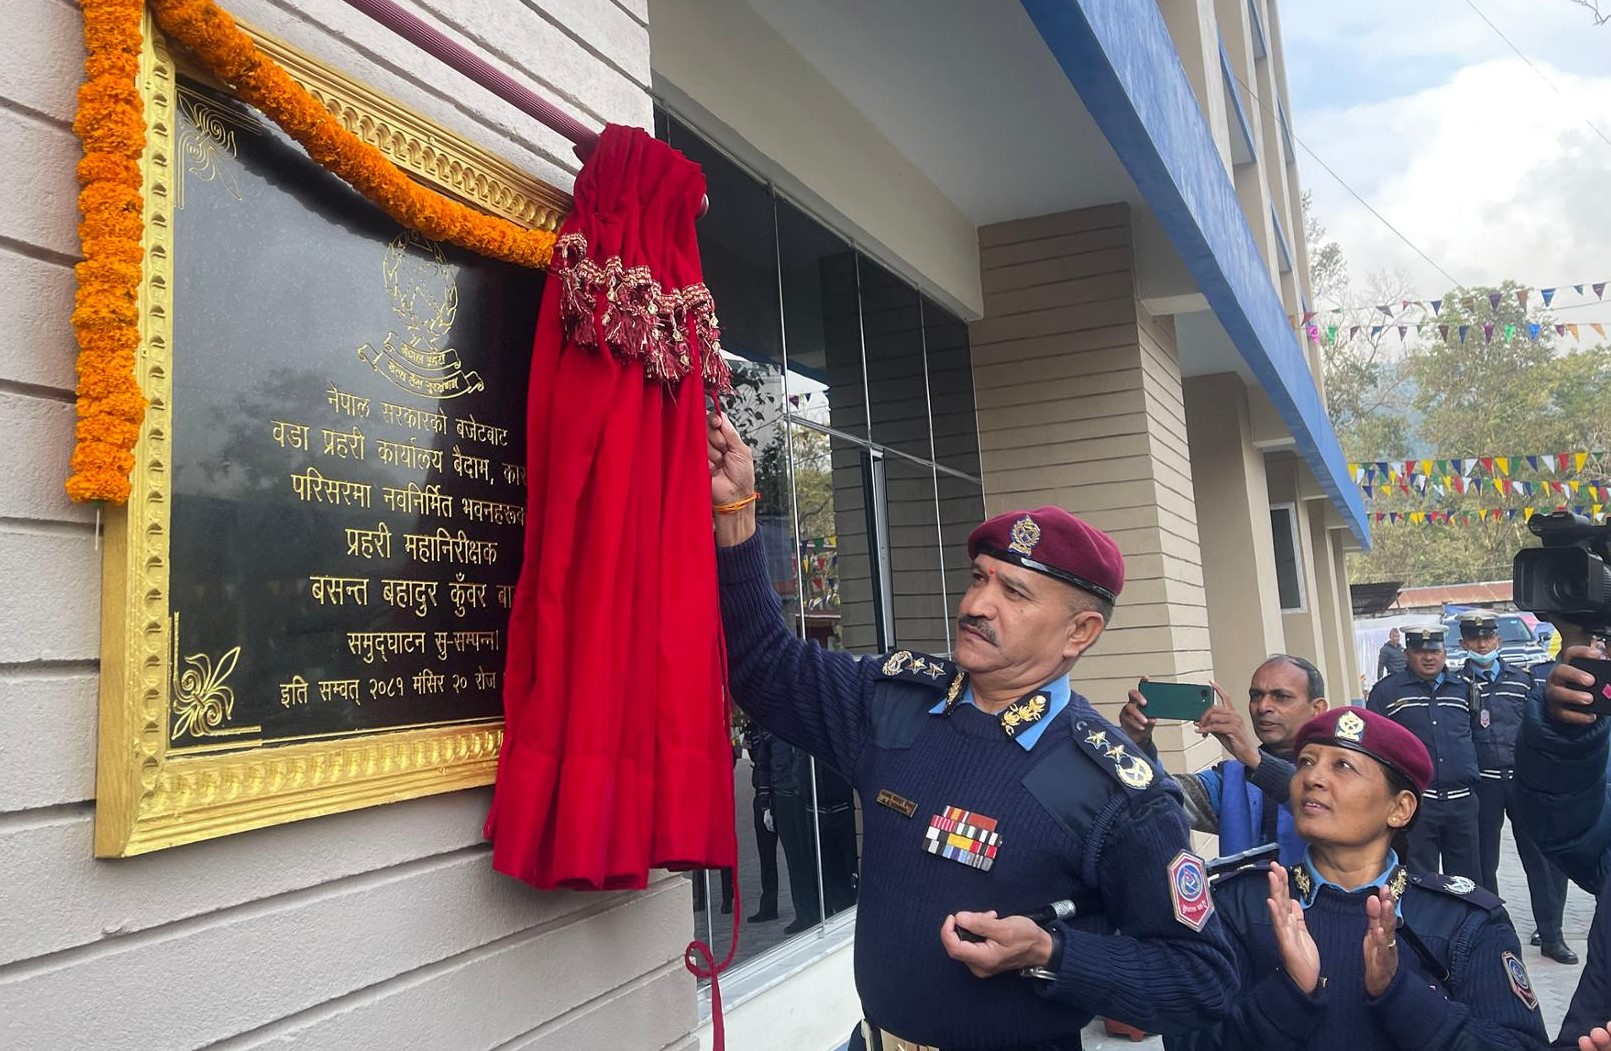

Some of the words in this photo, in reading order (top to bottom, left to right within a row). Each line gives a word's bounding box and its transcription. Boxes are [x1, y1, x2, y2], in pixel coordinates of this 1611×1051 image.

[326, 381, 370, 418] नेपाल
[380, 402, 447, 435] सरकारको
[455, 414, 508, 446] बजेटबाट
[271, 420, 309, 450] वडा
[322, 427, 365, 460] प्रहरी
[376, 437, 443, 473] कार्यालय
[452, 444, 494, 485] बैदाम,
[291, 467, 371, 508] परिसरमा
[383, 482, 453, 518] नवनिर्मित
[345, 522, 391, 559] प्रहरी
[403, 527, 498, 566] महानिरीक्षक
[310, 575, 369, 605] बसन्त
[381, 579, 438, 617] बहादुर
[449, 572, 487, 618] कुँवर
[280, 675, 309, 709] इति
[317, 679, 361, 706] सम्वत्
[369, 676, 405, 699] २०८१
[412, 668, 445, 695] मंसिर
[452, 673, 468, 693] २०
[474, 665, 497, 691] रोज
